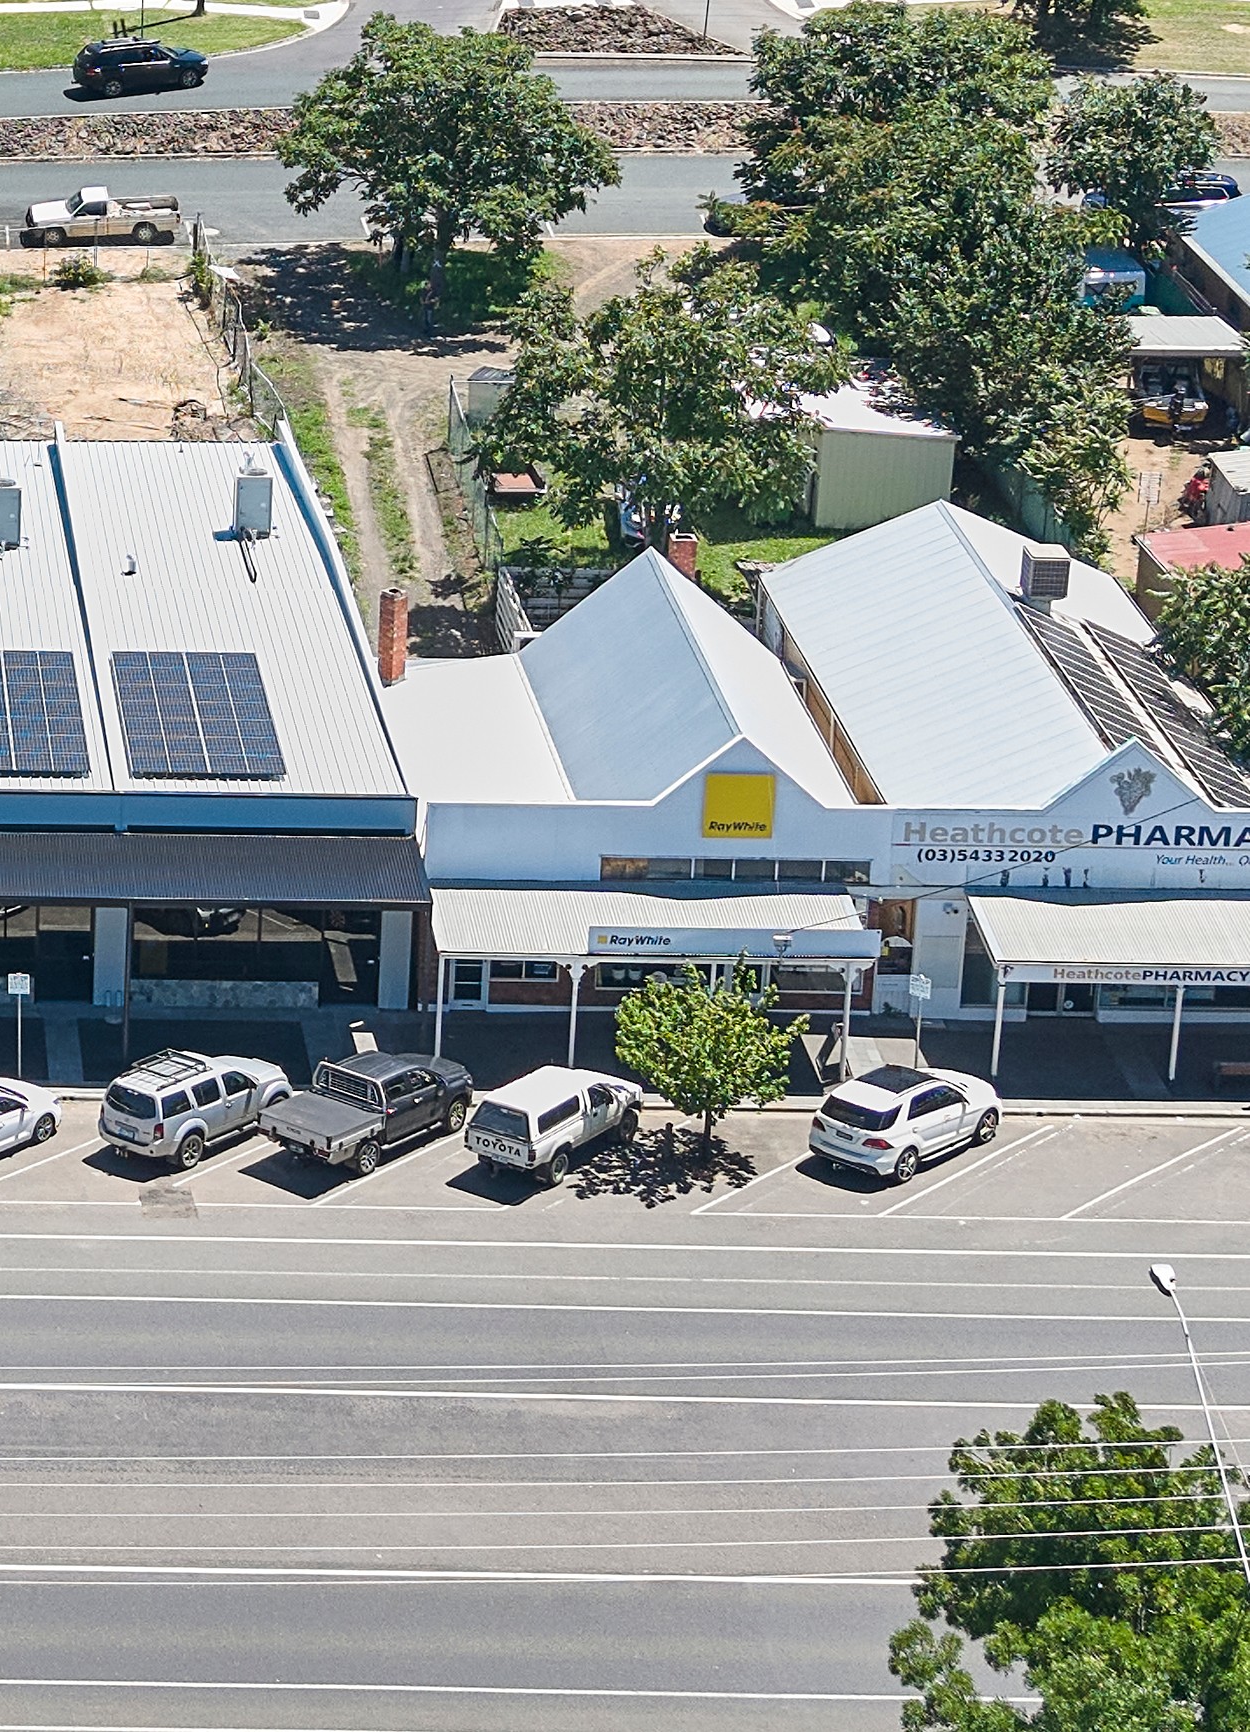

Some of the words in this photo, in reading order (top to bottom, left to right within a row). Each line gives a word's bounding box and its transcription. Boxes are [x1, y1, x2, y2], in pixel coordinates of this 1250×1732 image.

[903, 821, 1084, 844] Heathcote
[1156, 854, 1183, 865] Your
[610, 935, 671, 946] RayWhite
[475, 1136, 522, 1157] TOYOTA
